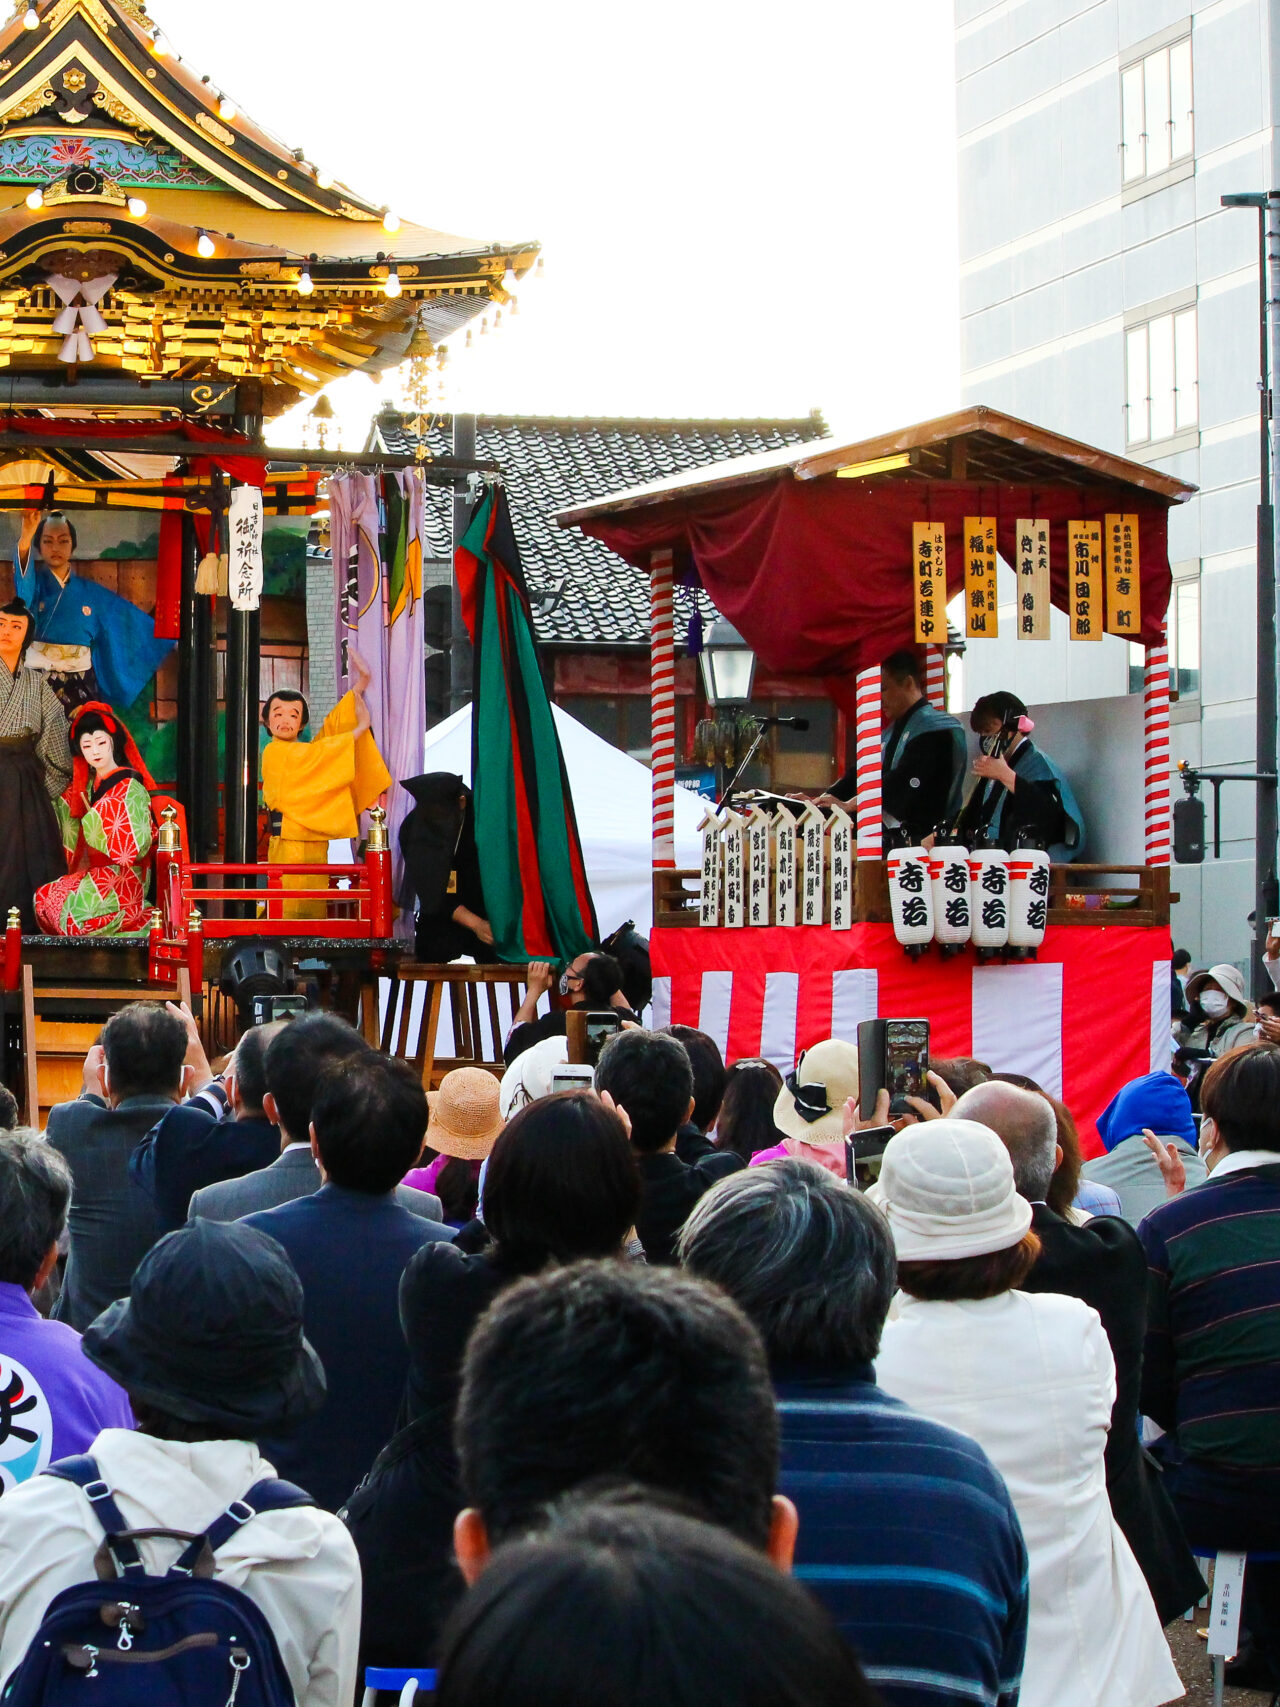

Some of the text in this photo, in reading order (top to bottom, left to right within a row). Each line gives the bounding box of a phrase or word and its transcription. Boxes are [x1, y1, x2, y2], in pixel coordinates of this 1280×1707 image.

[918, 540, 935, 637] 寺町若連中
[1115, 577, 1132, 628] 寺町
